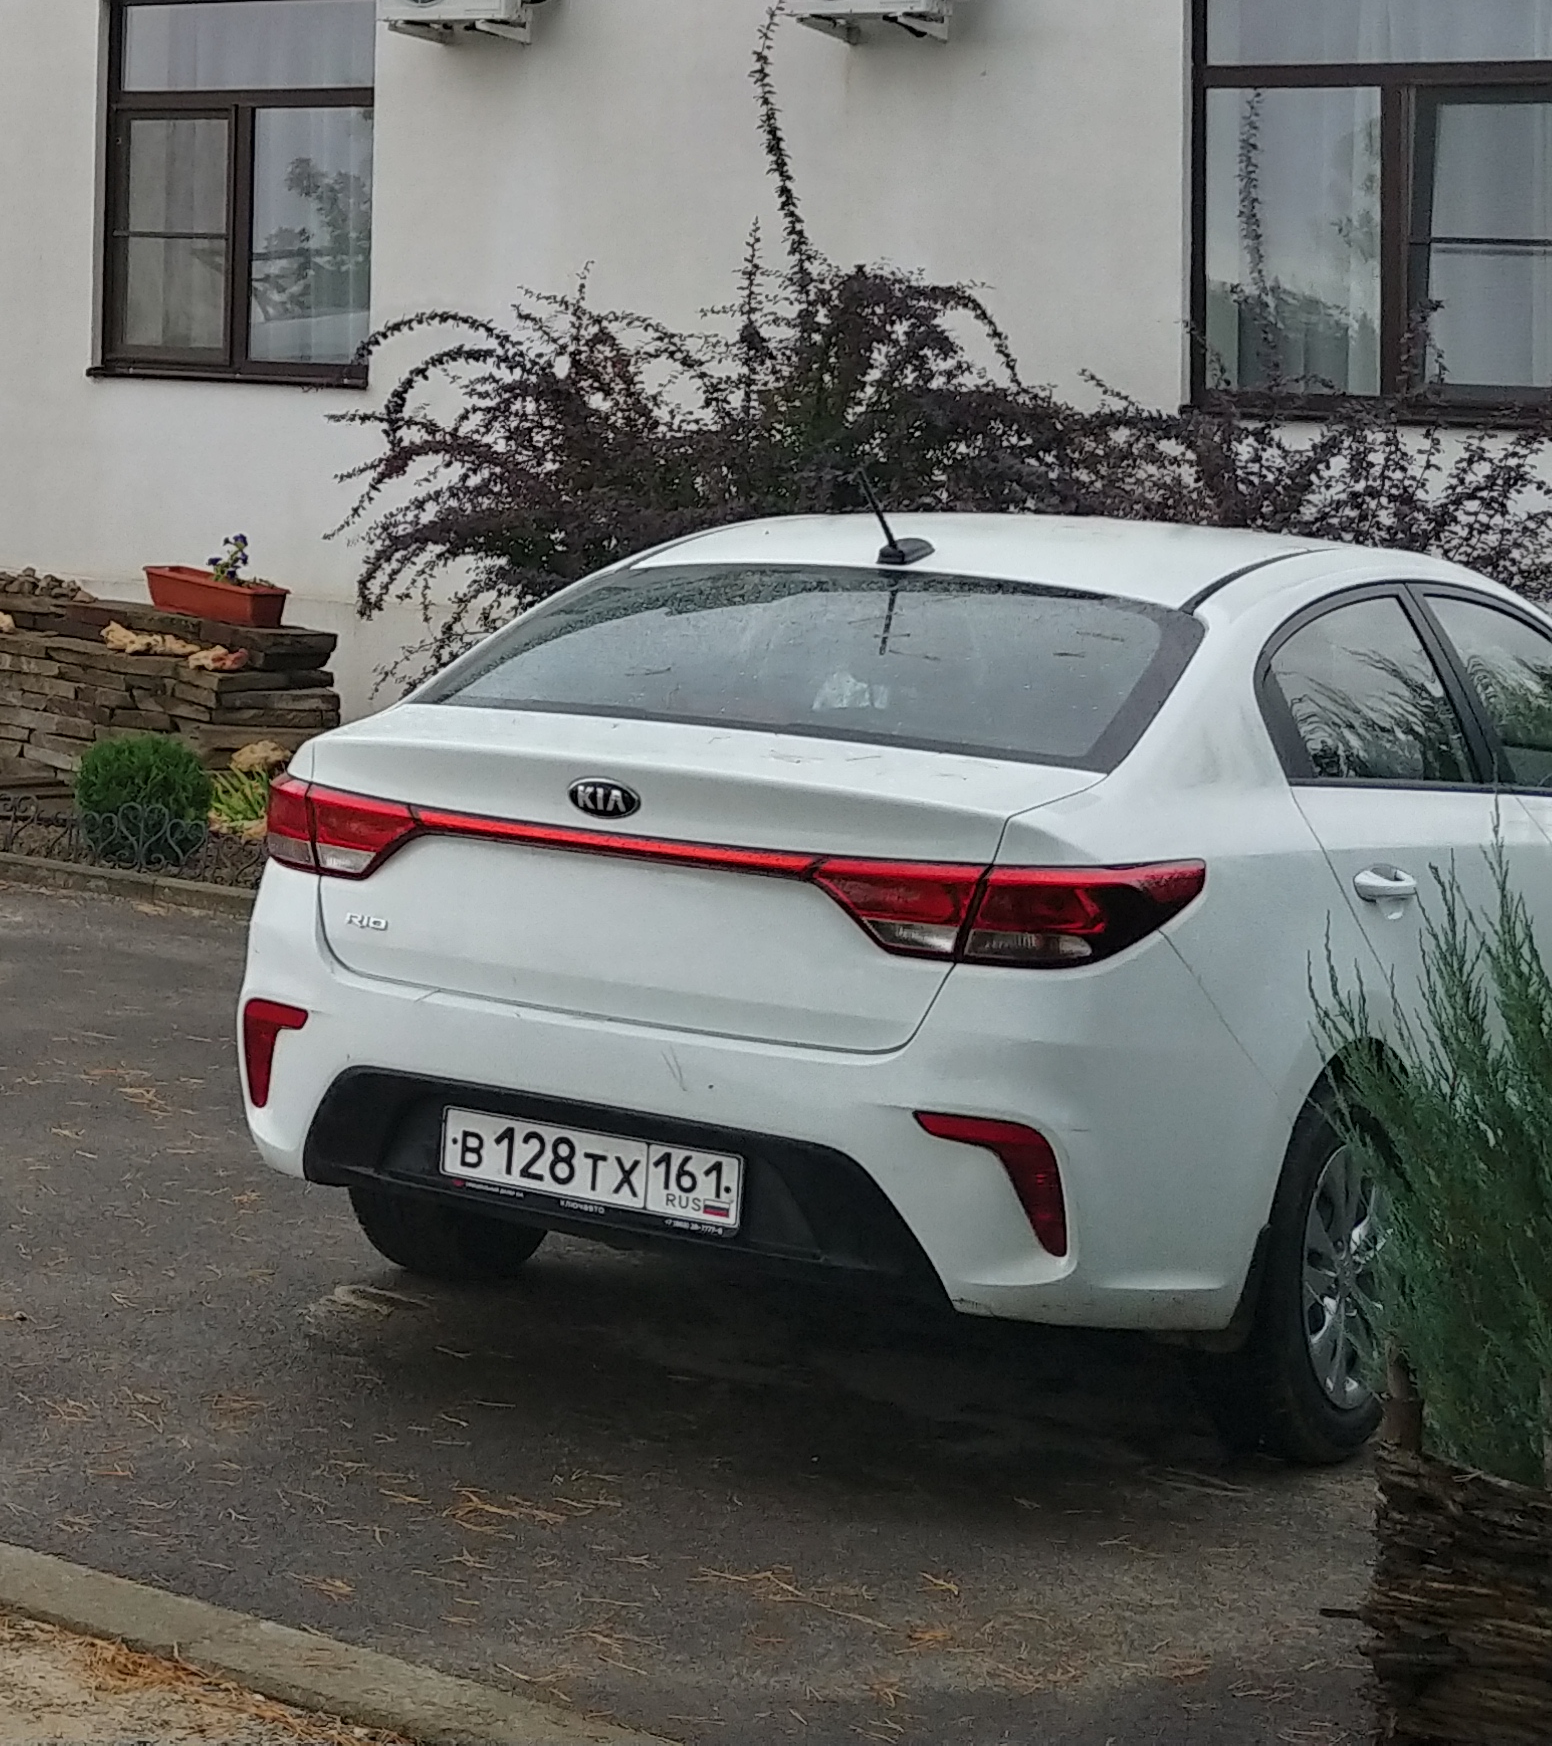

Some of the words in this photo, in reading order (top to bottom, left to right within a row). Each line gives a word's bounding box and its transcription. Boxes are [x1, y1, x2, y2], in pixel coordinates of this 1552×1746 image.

[576, 785, 627, 813] KIA
[345, 912, 389, 932] RIO
[652, 1151, 726, 1200] 161
[665, 1192, 702, 1213] RUS
